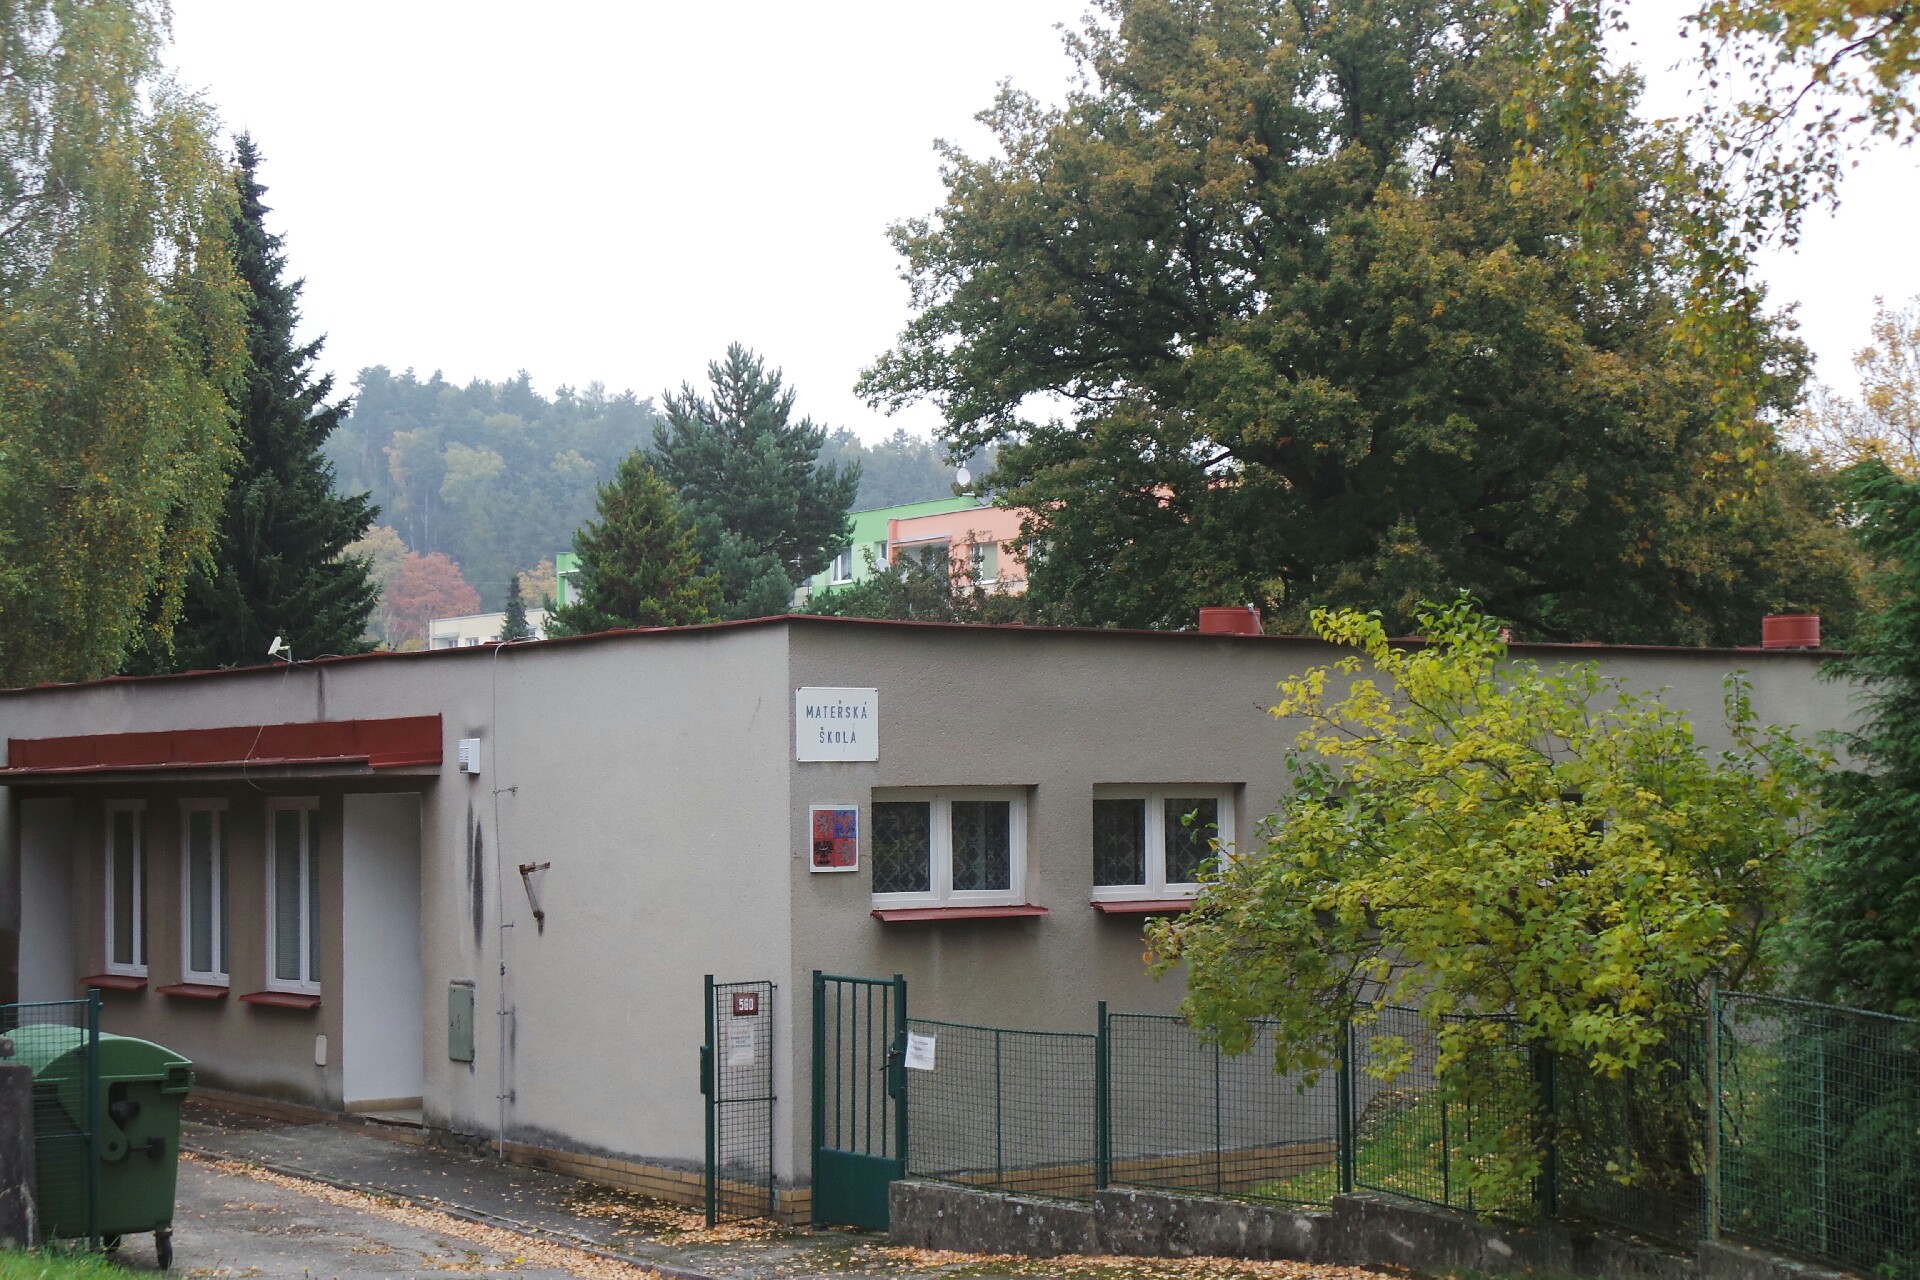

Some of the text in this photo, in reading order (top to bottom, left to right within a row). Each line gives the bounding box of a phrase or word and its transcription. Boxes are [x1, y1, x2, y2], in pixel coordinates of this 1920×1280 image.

[806, 700, 867, 719] MATEŘSKÁ
[819, 726, 856, 744] ŠKOLA
[738, 998, 754, 1011] 560
